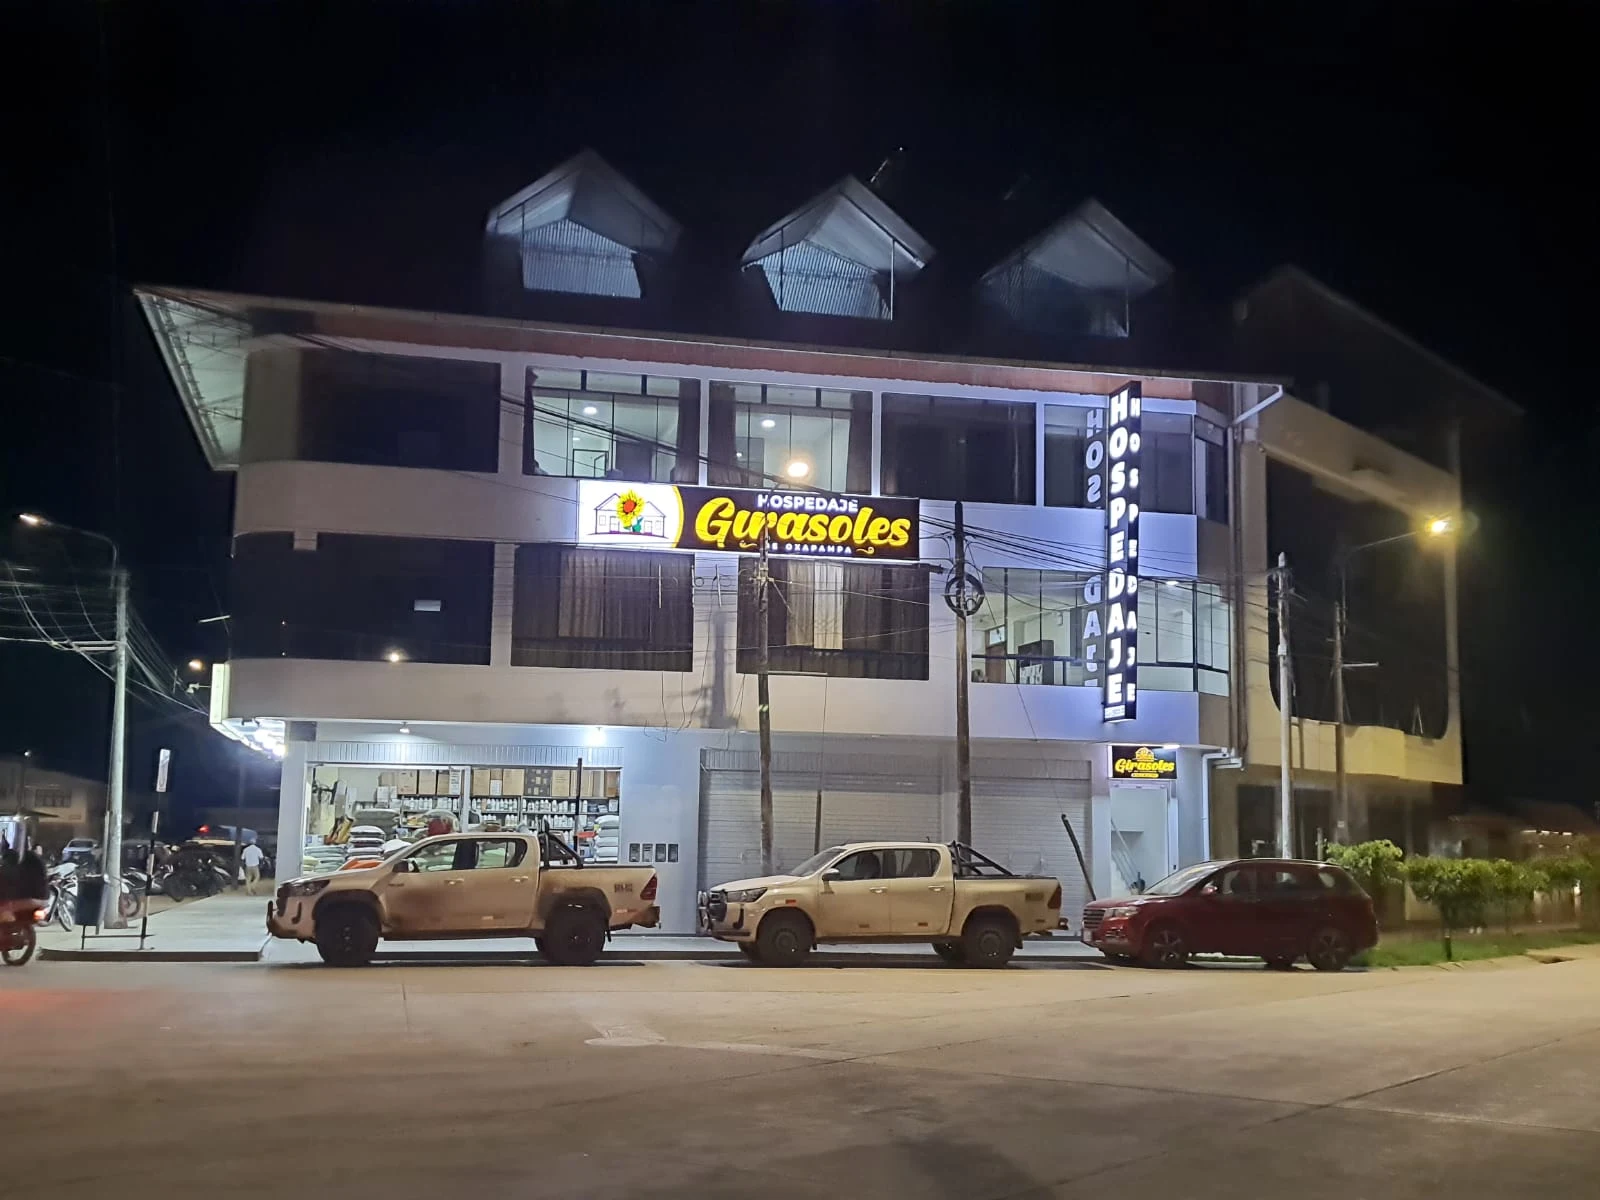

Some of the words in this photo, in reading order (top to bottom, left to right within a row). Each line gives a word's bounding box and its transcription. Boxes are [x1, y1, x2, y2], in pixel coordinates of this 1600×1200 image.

[757, 494, 858, 512] HOSPEDAJE
[695, 497, 911, 548] Girasoles
[785, 543, 852, 554] OXAPAMPA
[1109, 389, 1129, 704] HOSPEDAJE
[1115, 758, 1175, 773] Girasoles
